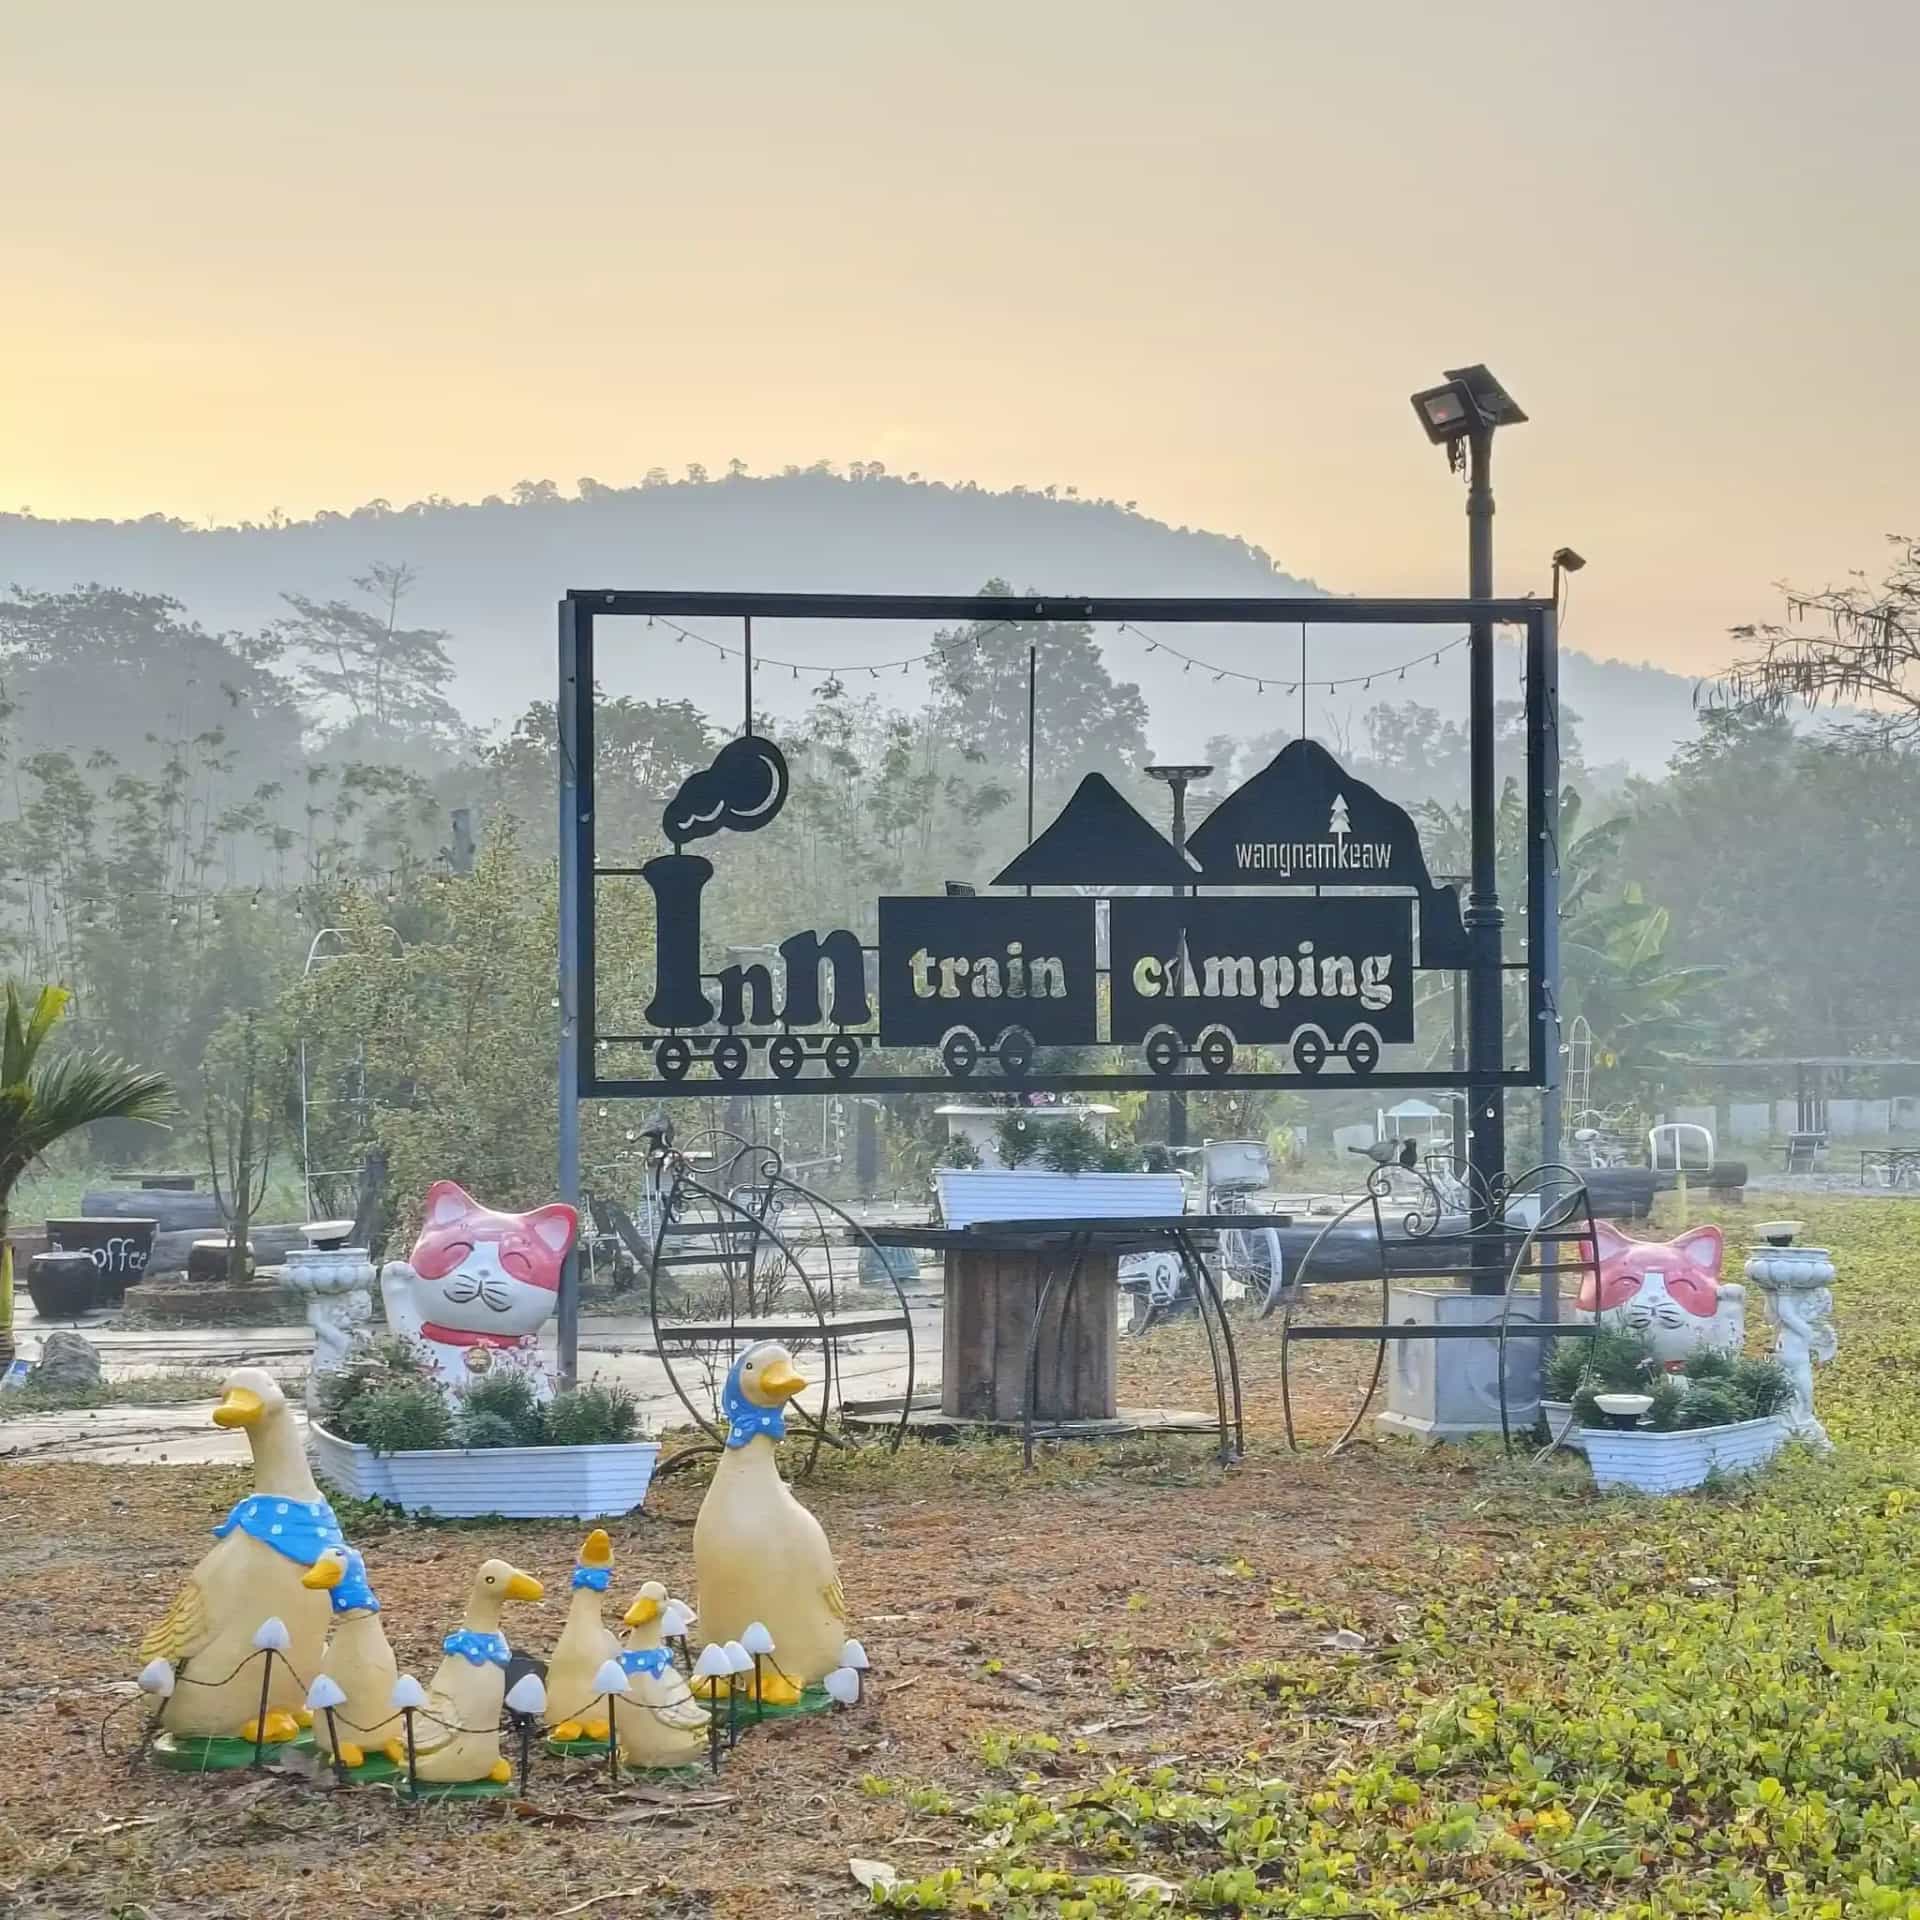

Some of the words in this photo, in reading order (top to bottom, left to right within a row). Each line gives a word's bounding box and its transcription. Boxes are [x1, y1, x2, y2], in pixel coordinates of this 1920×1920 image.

[1236, 838, 1392, 877] wangnamkeaw
[643, 855, 872, 1028] Inn
[908, 942, 1068, 998] train
[79, 1238, 148, 1272] offee
